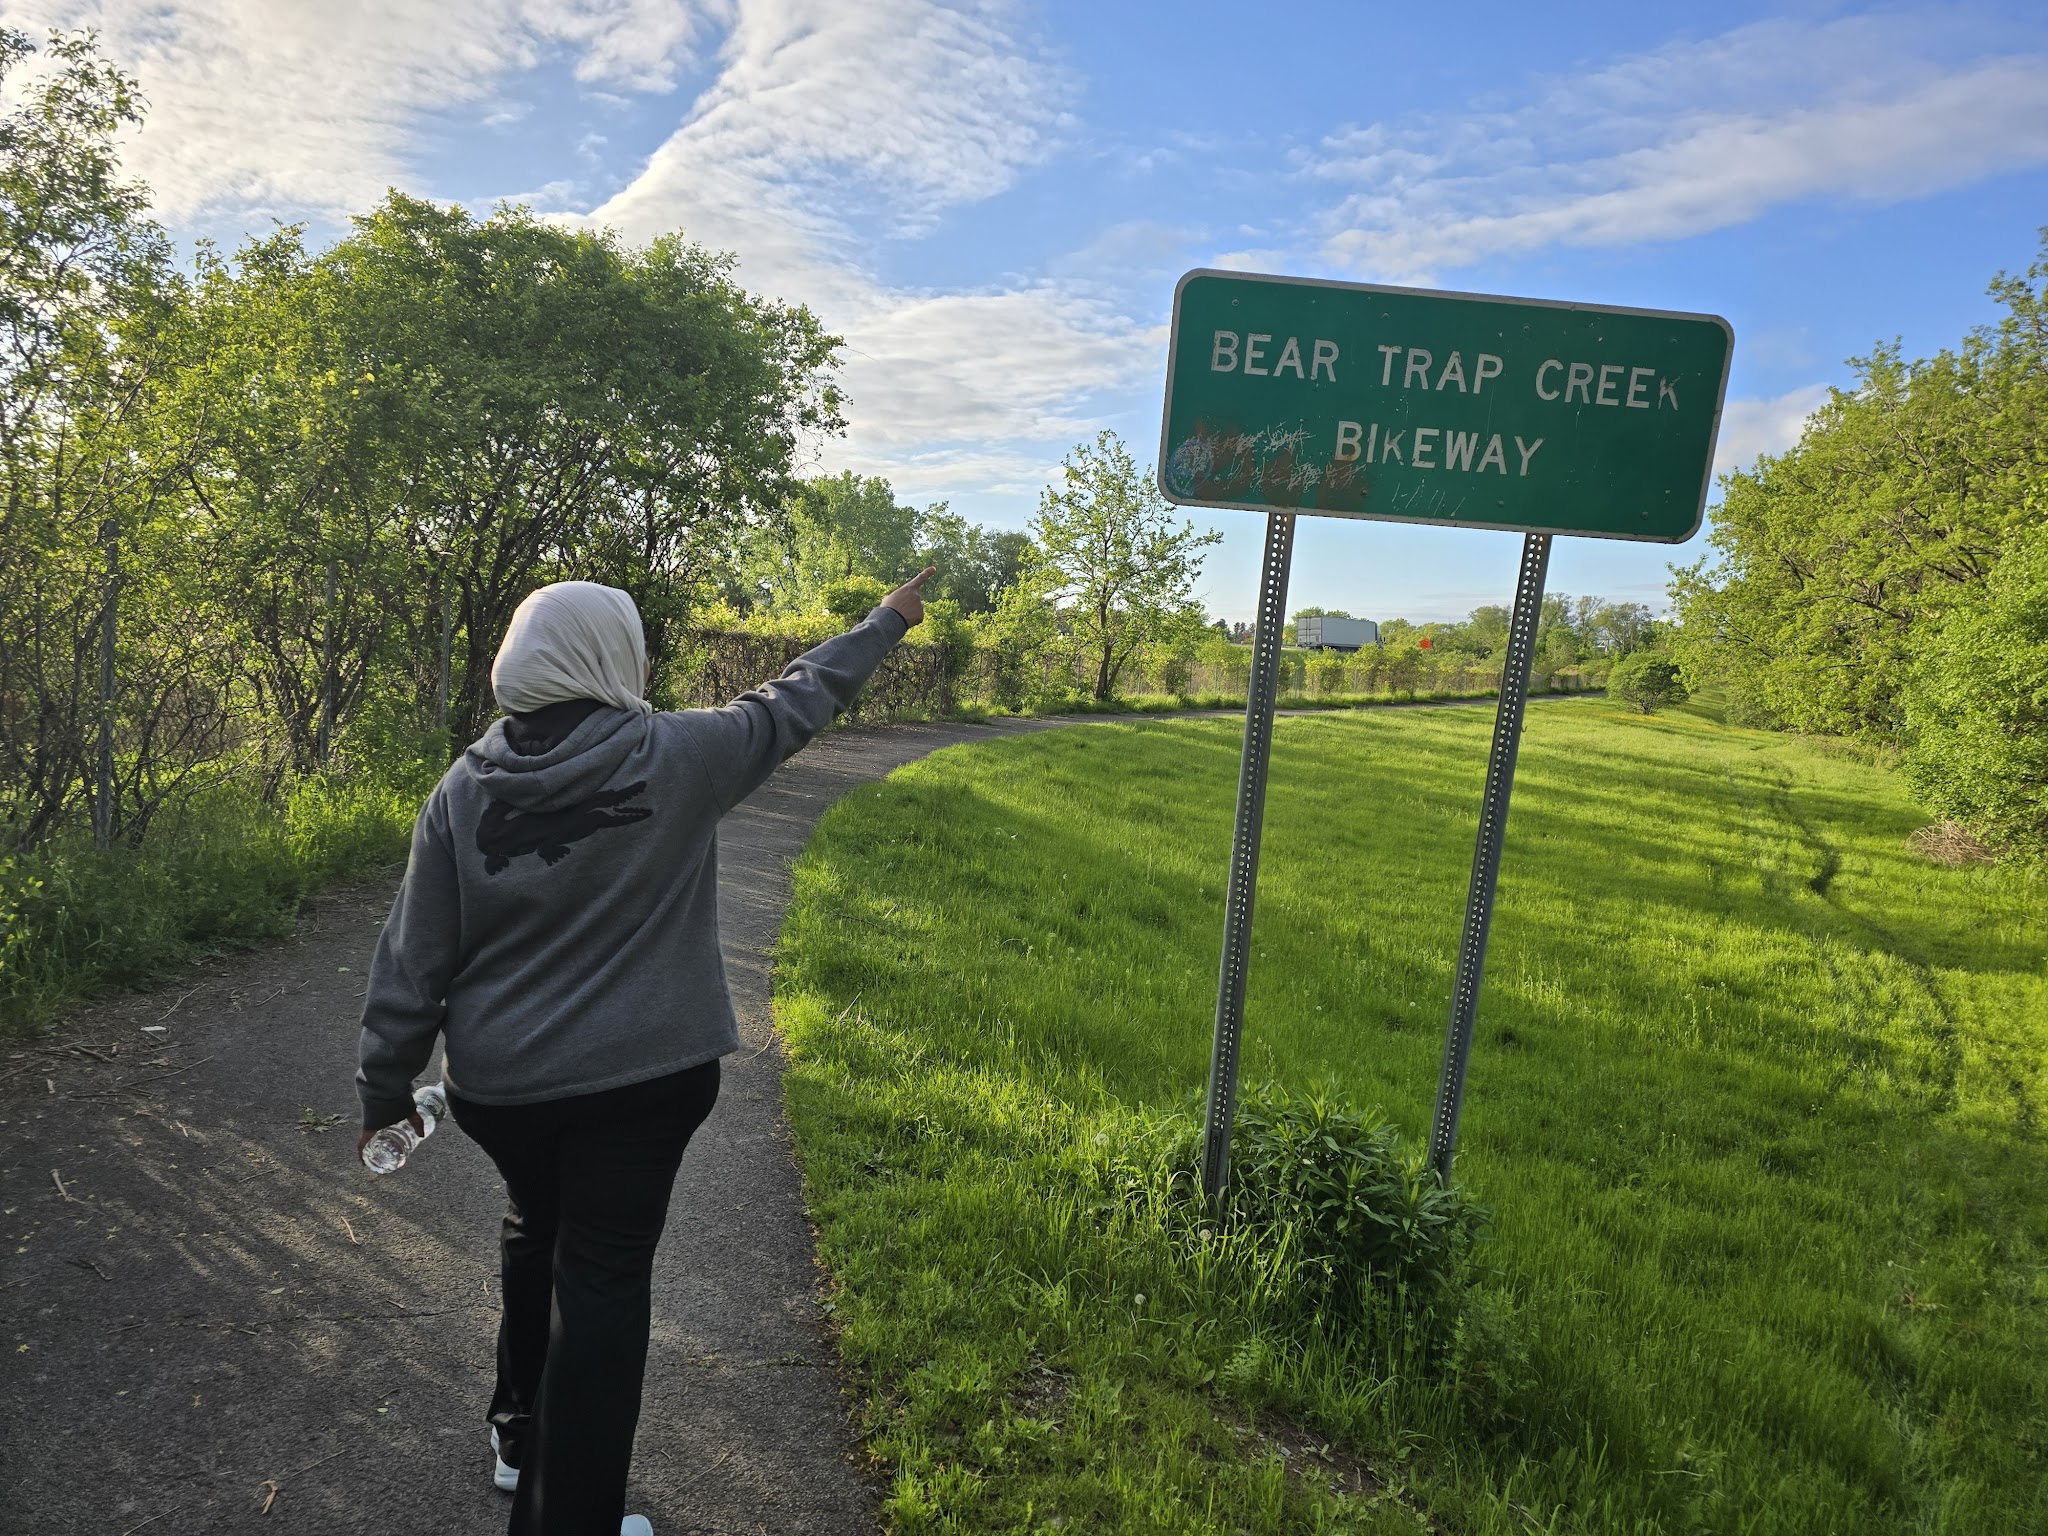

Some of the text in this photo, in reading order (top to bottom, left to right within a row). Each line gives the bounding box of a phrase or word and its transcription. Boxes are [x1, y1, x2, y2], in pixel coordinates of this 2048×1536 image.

[1210, 330, 1681, 411] BEAR TRAP CREEK
[1334, 420, 1545, 477] BIKEWAY
